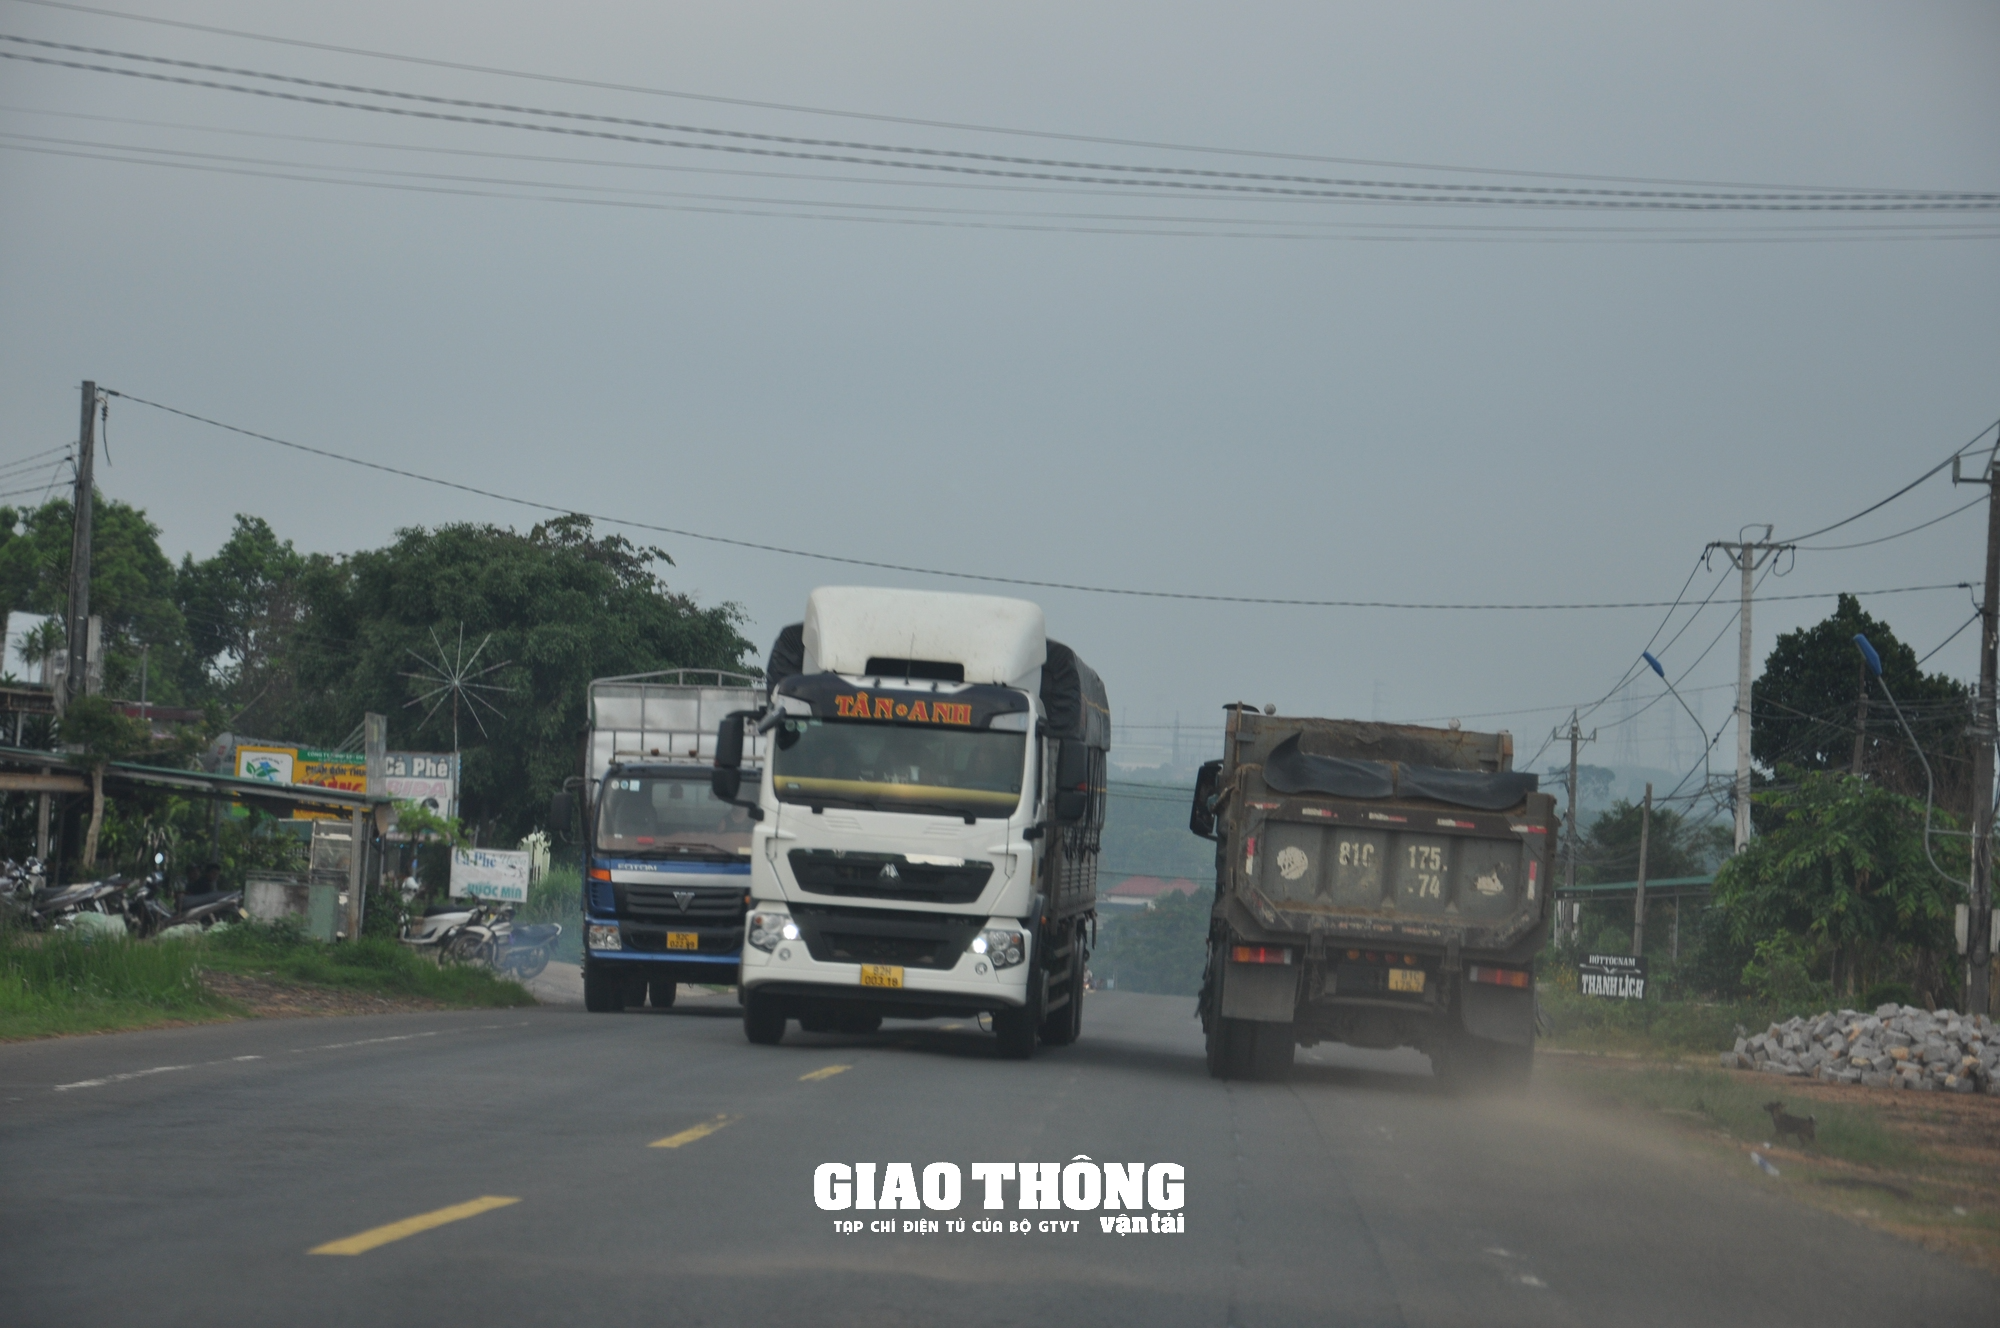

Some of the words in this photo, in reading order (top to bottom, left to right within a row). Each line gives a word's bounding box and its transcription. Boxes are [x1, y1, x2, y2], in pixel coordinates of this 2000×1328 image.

[835, 691, 894, 719] TÂN
[907, 700, 972, 725] ANH
[413, 757, 448, 777] Phê
[386, 781, 447, 798] BIDA
[618, 863, 657, 871] FOTON
[1581, 974, 1618, 996] THANH
